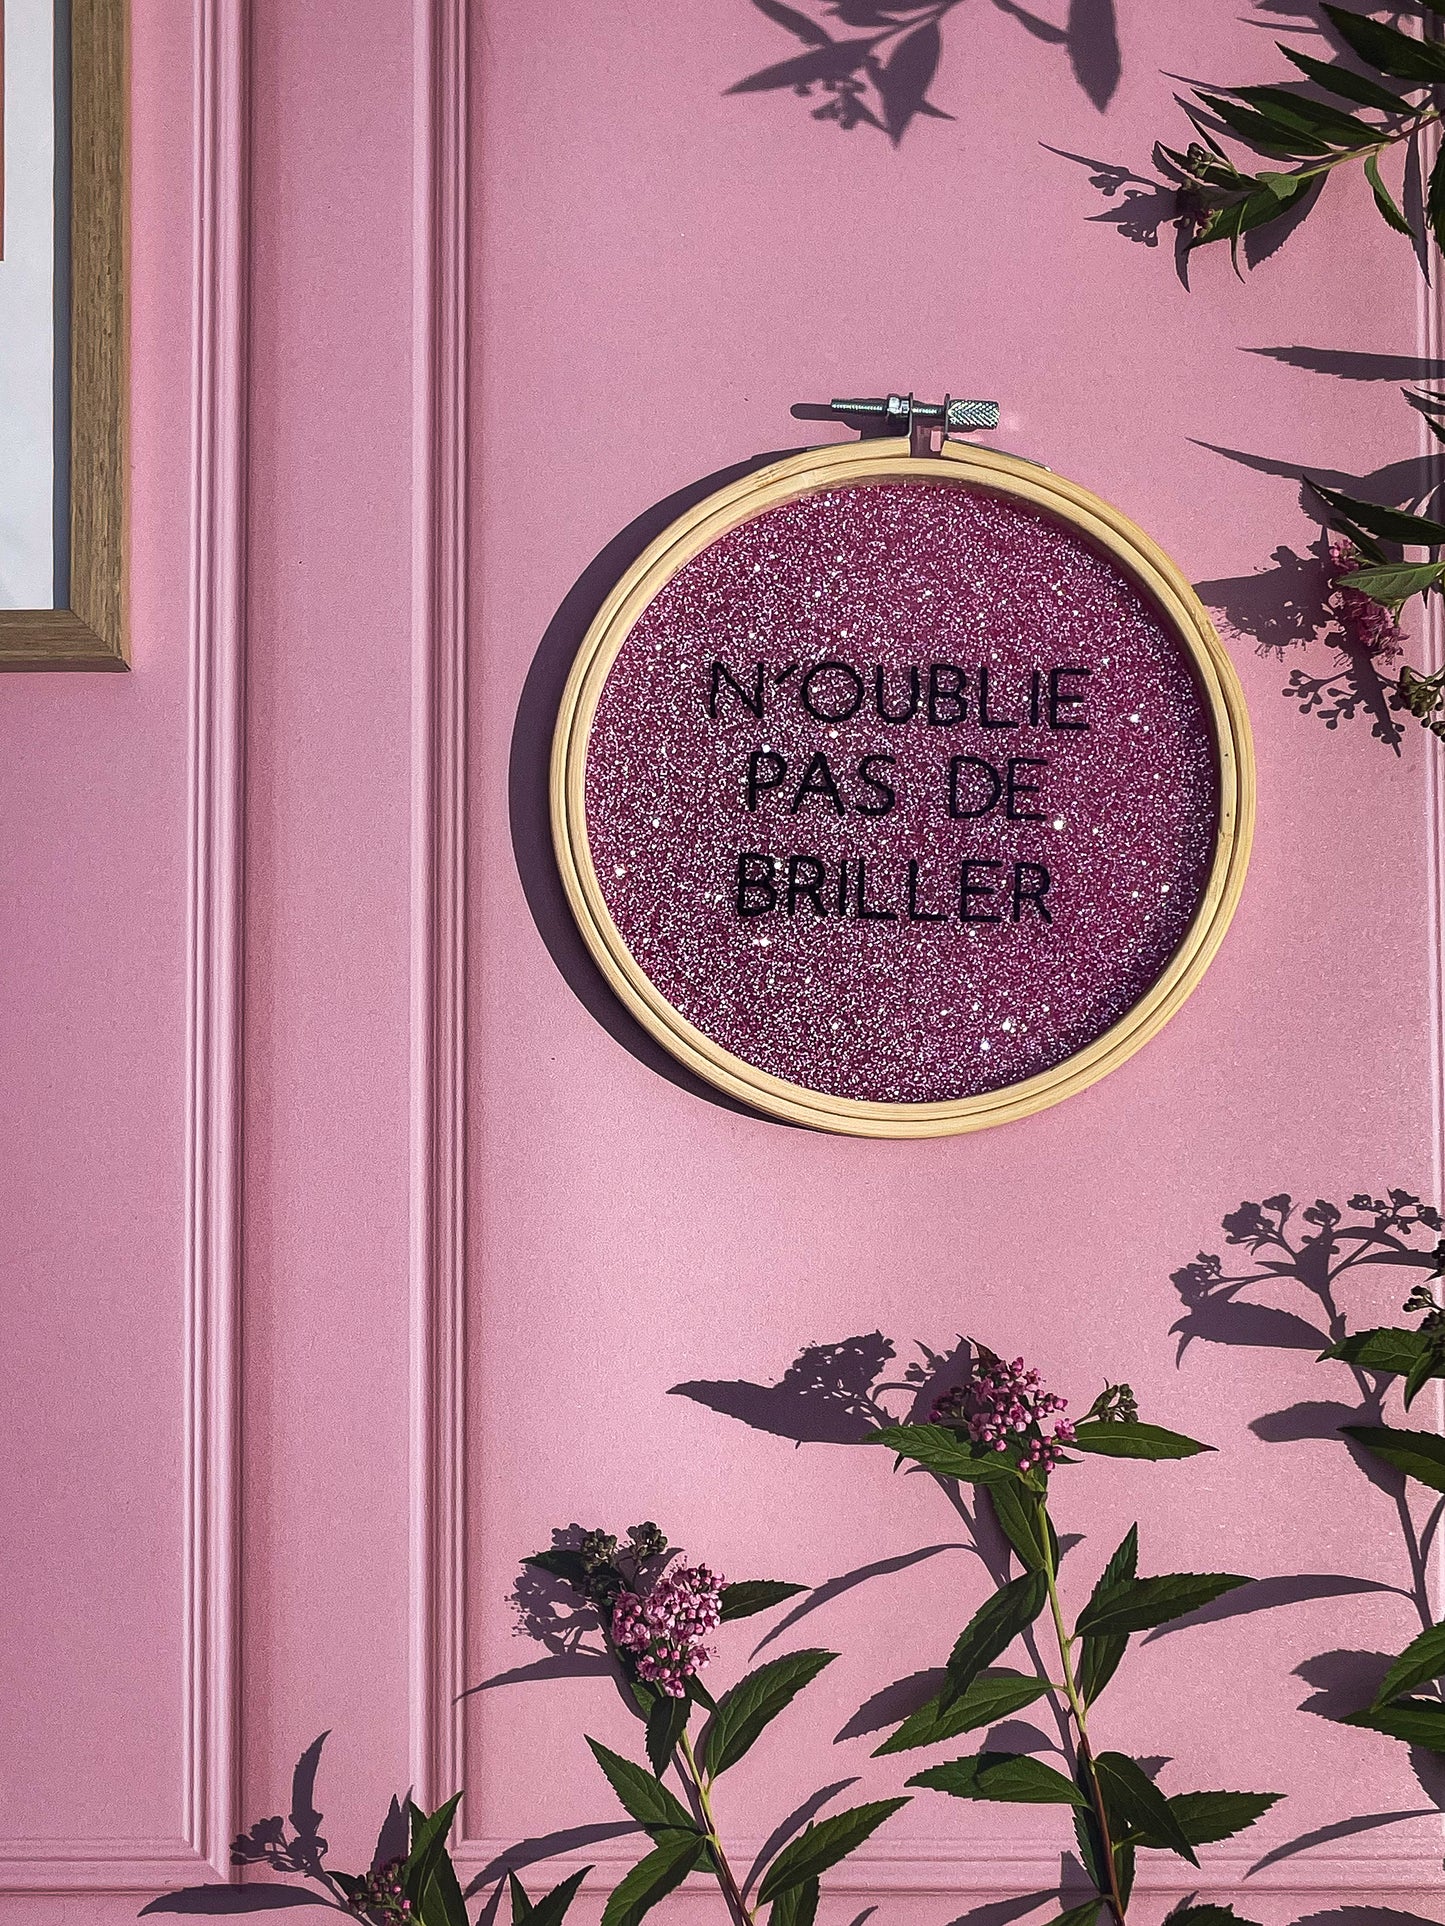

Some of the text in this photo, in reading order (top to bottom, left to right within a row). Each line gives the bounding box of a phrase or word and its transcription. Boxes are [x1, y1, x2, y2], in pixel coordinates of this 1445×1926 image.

[747, 750, 1050, 821] PAS DE
[736, 852, 1054, 924] BRILLER
